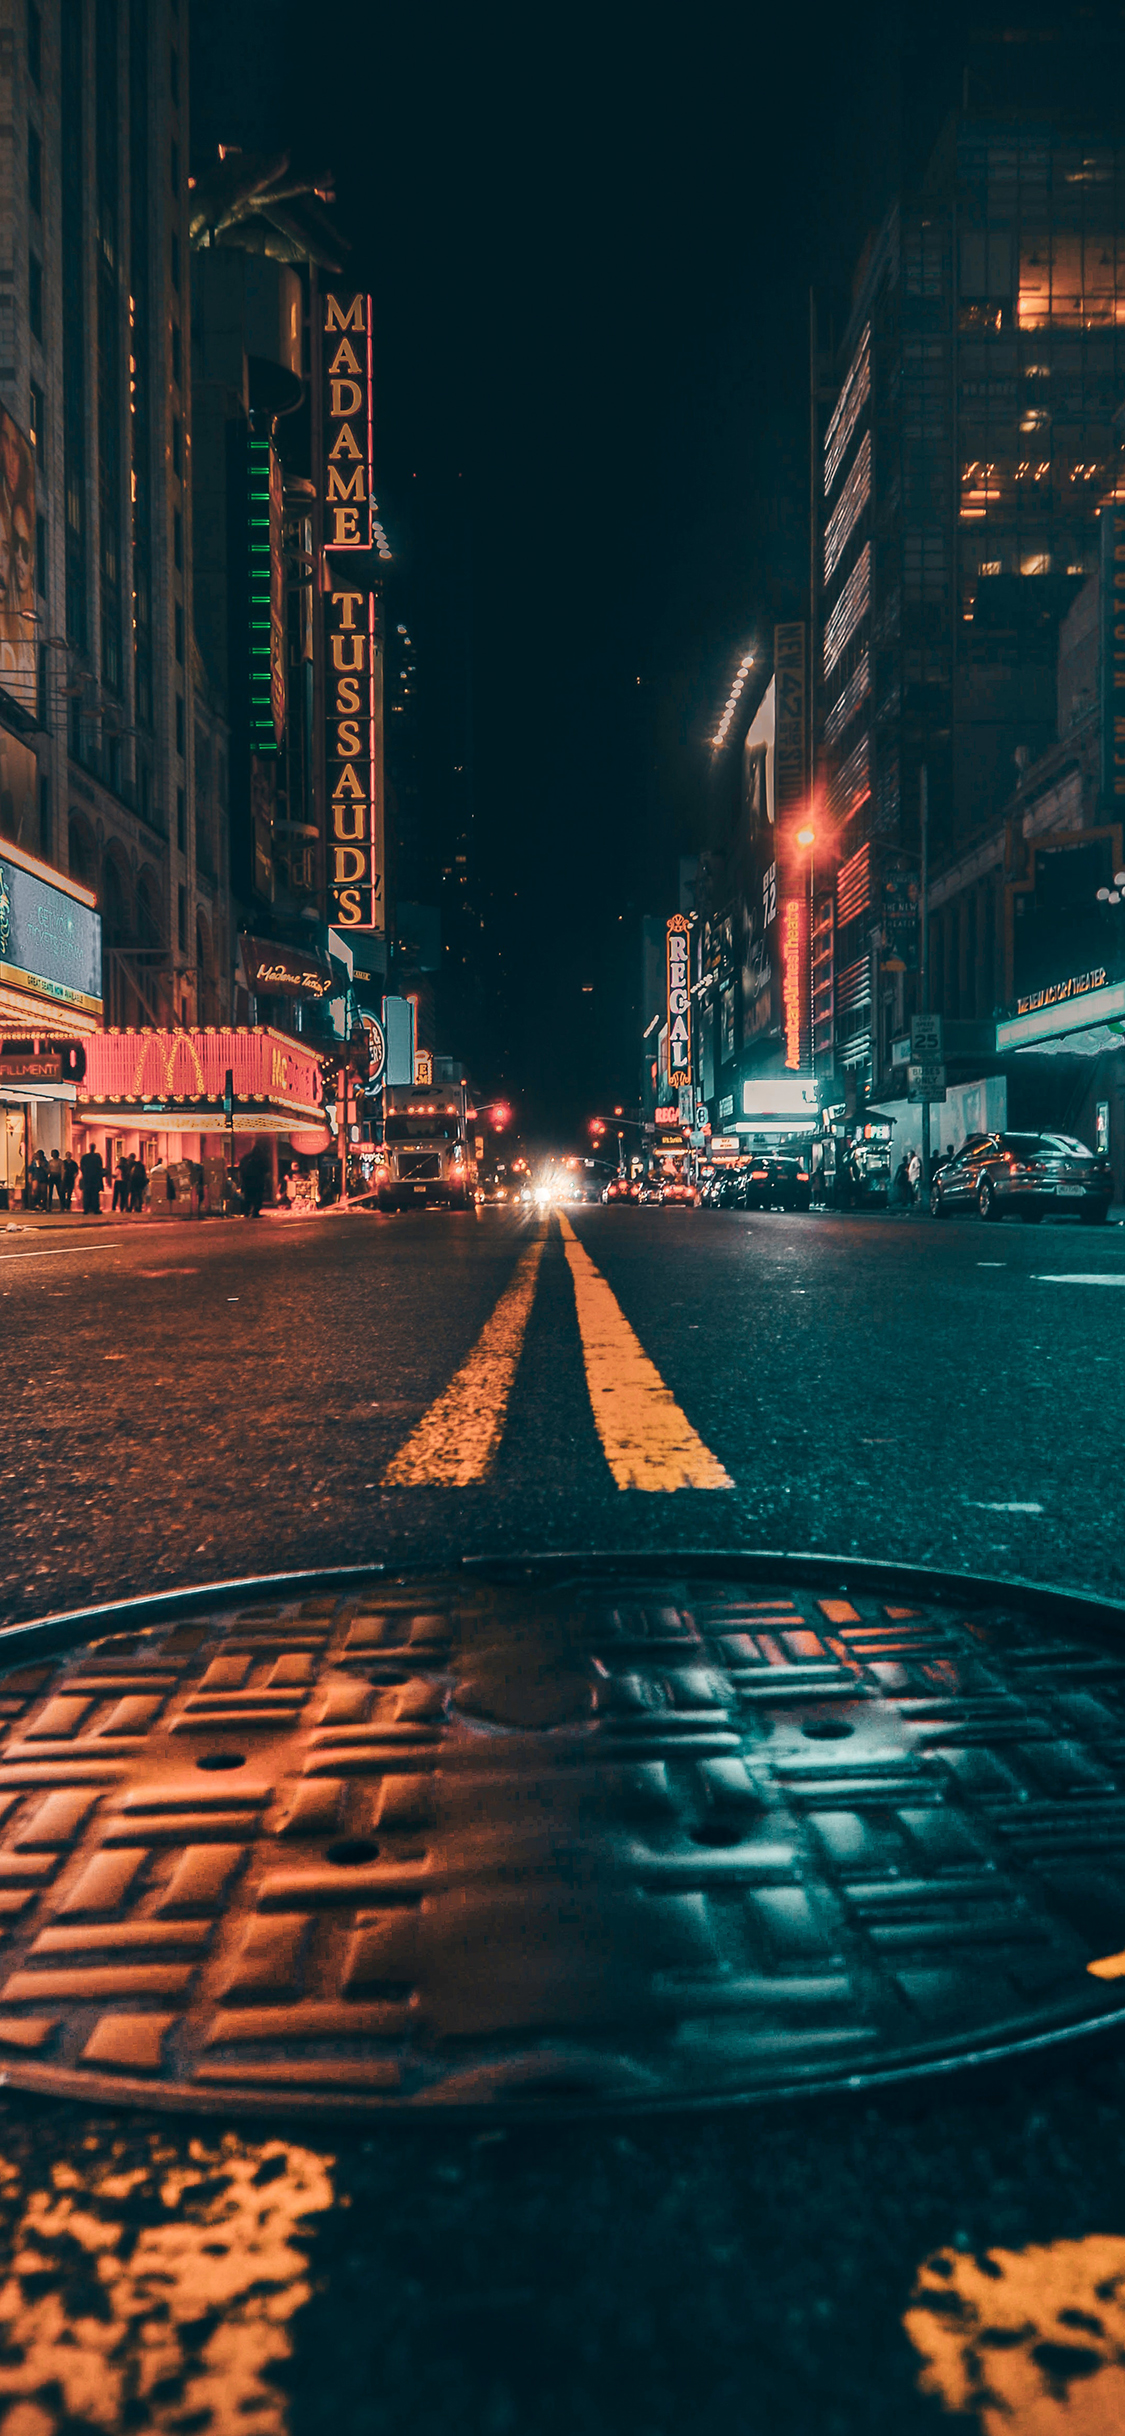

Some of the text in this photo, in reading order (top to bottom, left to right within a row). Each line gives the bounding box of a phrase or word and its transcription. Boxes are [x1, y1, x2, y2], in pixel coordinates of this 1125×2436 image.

[324, 293, 367, 545] MADAME
[778, 625, 802, 668] NEW
[779, 672, 801, 718] 42
[330, 591, 367, 925] TUSSAUD'S
[762, 881, 777, 930] 72
[898, 902, 918, 911] NEW
[27, 975, 41, 987] GREAT
[41, 980, 54, 993] SEATS
[54, 984, 63, 996] NOW
[1072, 966, 1106, 995] THEATER
[669, 936, 692, 1069] REGAL
[914, 1034, 939, 1049] 25
[912, 1067, 940, 1076] BUSES
[915, 1076, 938, 1085] ONLY
[655, 1106, 680, 1124] REGA
[864, 1122, 891, 1139] OPEN
